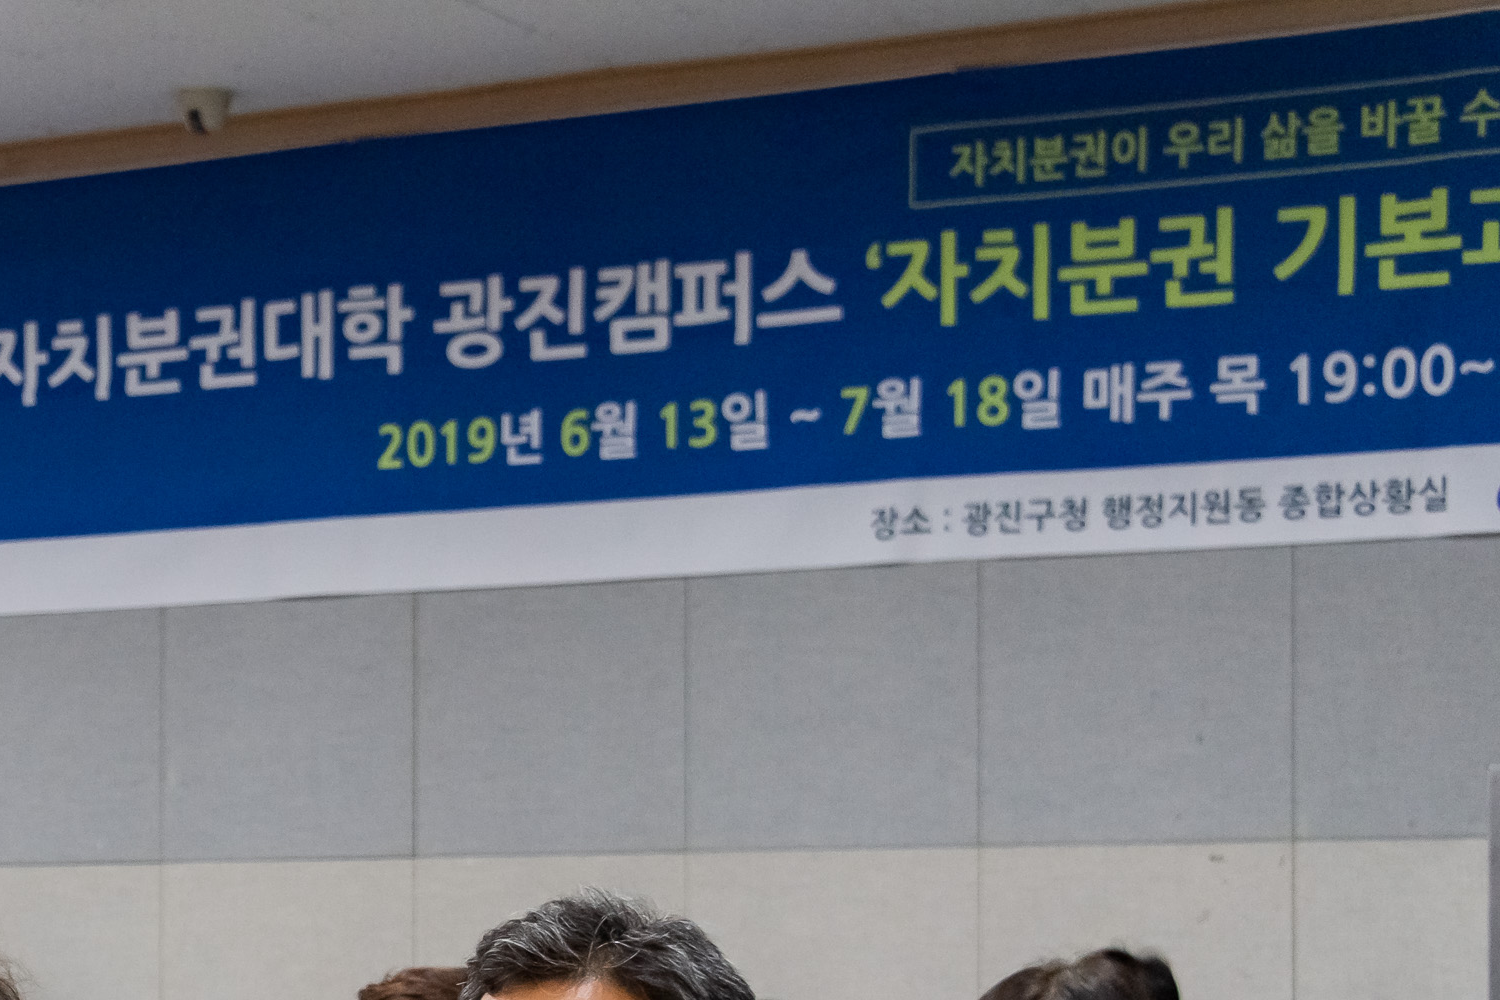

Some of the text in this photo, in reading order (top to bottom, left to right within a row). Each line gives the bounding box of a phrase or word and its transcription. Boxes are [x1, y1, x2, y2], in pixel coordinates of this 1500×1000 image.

[949, 88, 1500, 187] 자치분권이 우리 삶을 바꿀 수
[432, 250, 844, 370] 광진캠퍼스
[377, 407, 543, 470] 2019년
[560, 401, 637, 460] 6월
[659, 390, 768, 452] 13일
[840, 377, 922, 439] 7월
[947, 368, 1061, 431] 18일
[1083, 361, 1192, 424] 매주
[1209, 354, 1267, 415] 목
[1289, 342, 1495, 405] 19:00~
[871, 505, 932, 541] 장소
[963, 497, 1089, 537] 광진구청
[1102, 486, 1267, 530] 행정지원동
[1277, 474, 1448, 520] 종합상황실
